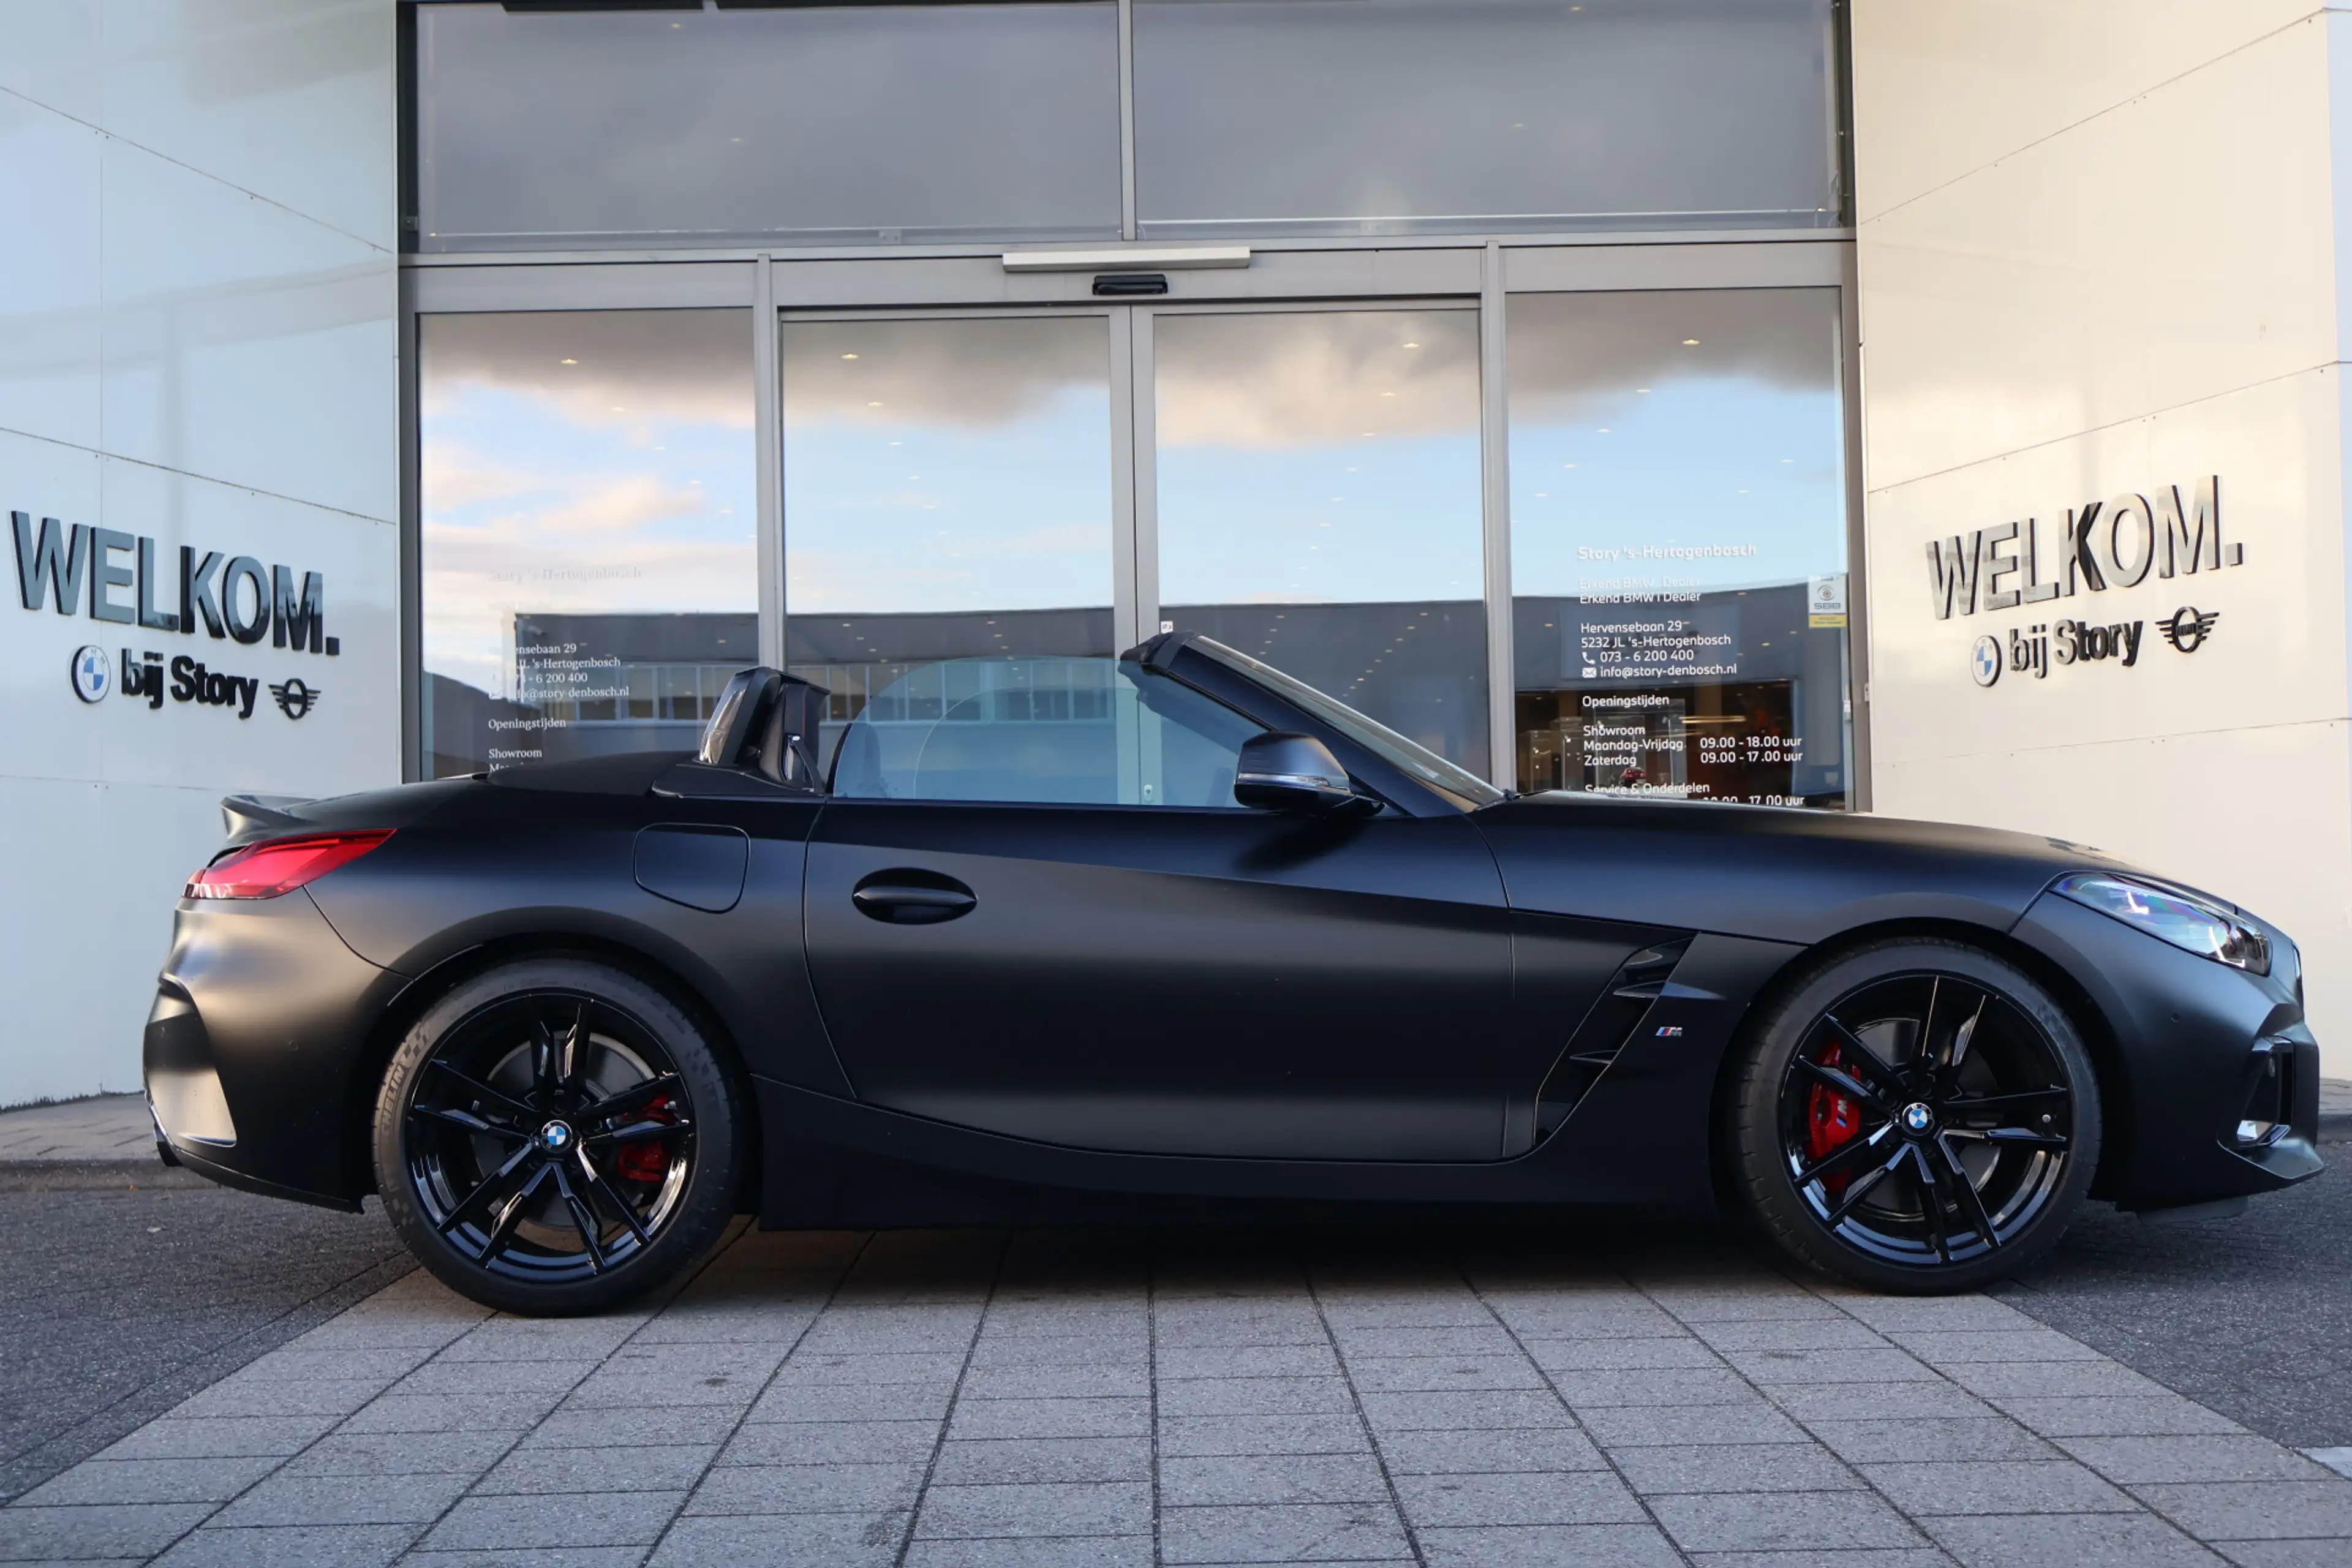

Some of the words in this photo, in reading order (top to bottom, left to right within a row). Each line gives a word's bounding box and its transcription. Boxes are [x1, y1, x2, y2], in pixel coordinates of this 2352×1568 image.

[1925, 475, 2244, 620] WELKOM.
[1578, 548, 1619, 562] Story
[11, 510, 340, 655] WELKOM.
[1579, 592, 1620, 603] Erkend
[1623, 592, 1654, 603] BMW
[1663, 592, 1701, 602] Dealer
[1581, 622, 1665, 633] Hervensebaan
[1667, 620, 1682, 631] 29
[1581, 636, 1610, 648] 5232
[1612, 636, 1626, 648] JL
[1628, 634, 1732, 648] 's-Hertogenbosch
[564, 643, 578, 654] 29
[1600, 651, 1622, 662] 073
[1633, 651, 1641, 662] 6
[1644, 650, 1667, 662] 200
[1671, 649, 1694, 660] 400
[2010, 624, 2048, 679] bij
[2053, 619, 2143, 667] Story
[1600, 663, 1737, 679] info@story-denbosch.nl
[121, 648, 164, 709] bij
[170, 655, 258, 720] Story
[536, 674, 543, 683] 6
[546, 674, 565, 684] 200
[568, 673, 588, 682] 400
[1582, 695, 1670, 709] Openingstijden
[488, 718, 567, 732] Openingstijden
[1583, 725, 1646, 737] Showroom
[1583, 738, 1684, 752] Maandag-Vrijdag
[1700, 737, 1736, 748] 09.00
[1746, 736, 1779, 747] 18.00
[1782, 737, 1802, 747] uur
[489, 748, 542, 759] Showroom
[1584, 755, 1637, 767] Zaterdag
[1700, 752, 1736, 763] 09.00
[1784, 752, 1803, 761] uur
[1630, 784, 1640, 794] &
[1643, 783, 1710, 794] Onderdelen
[1785, 796, 1804, 805] uur
